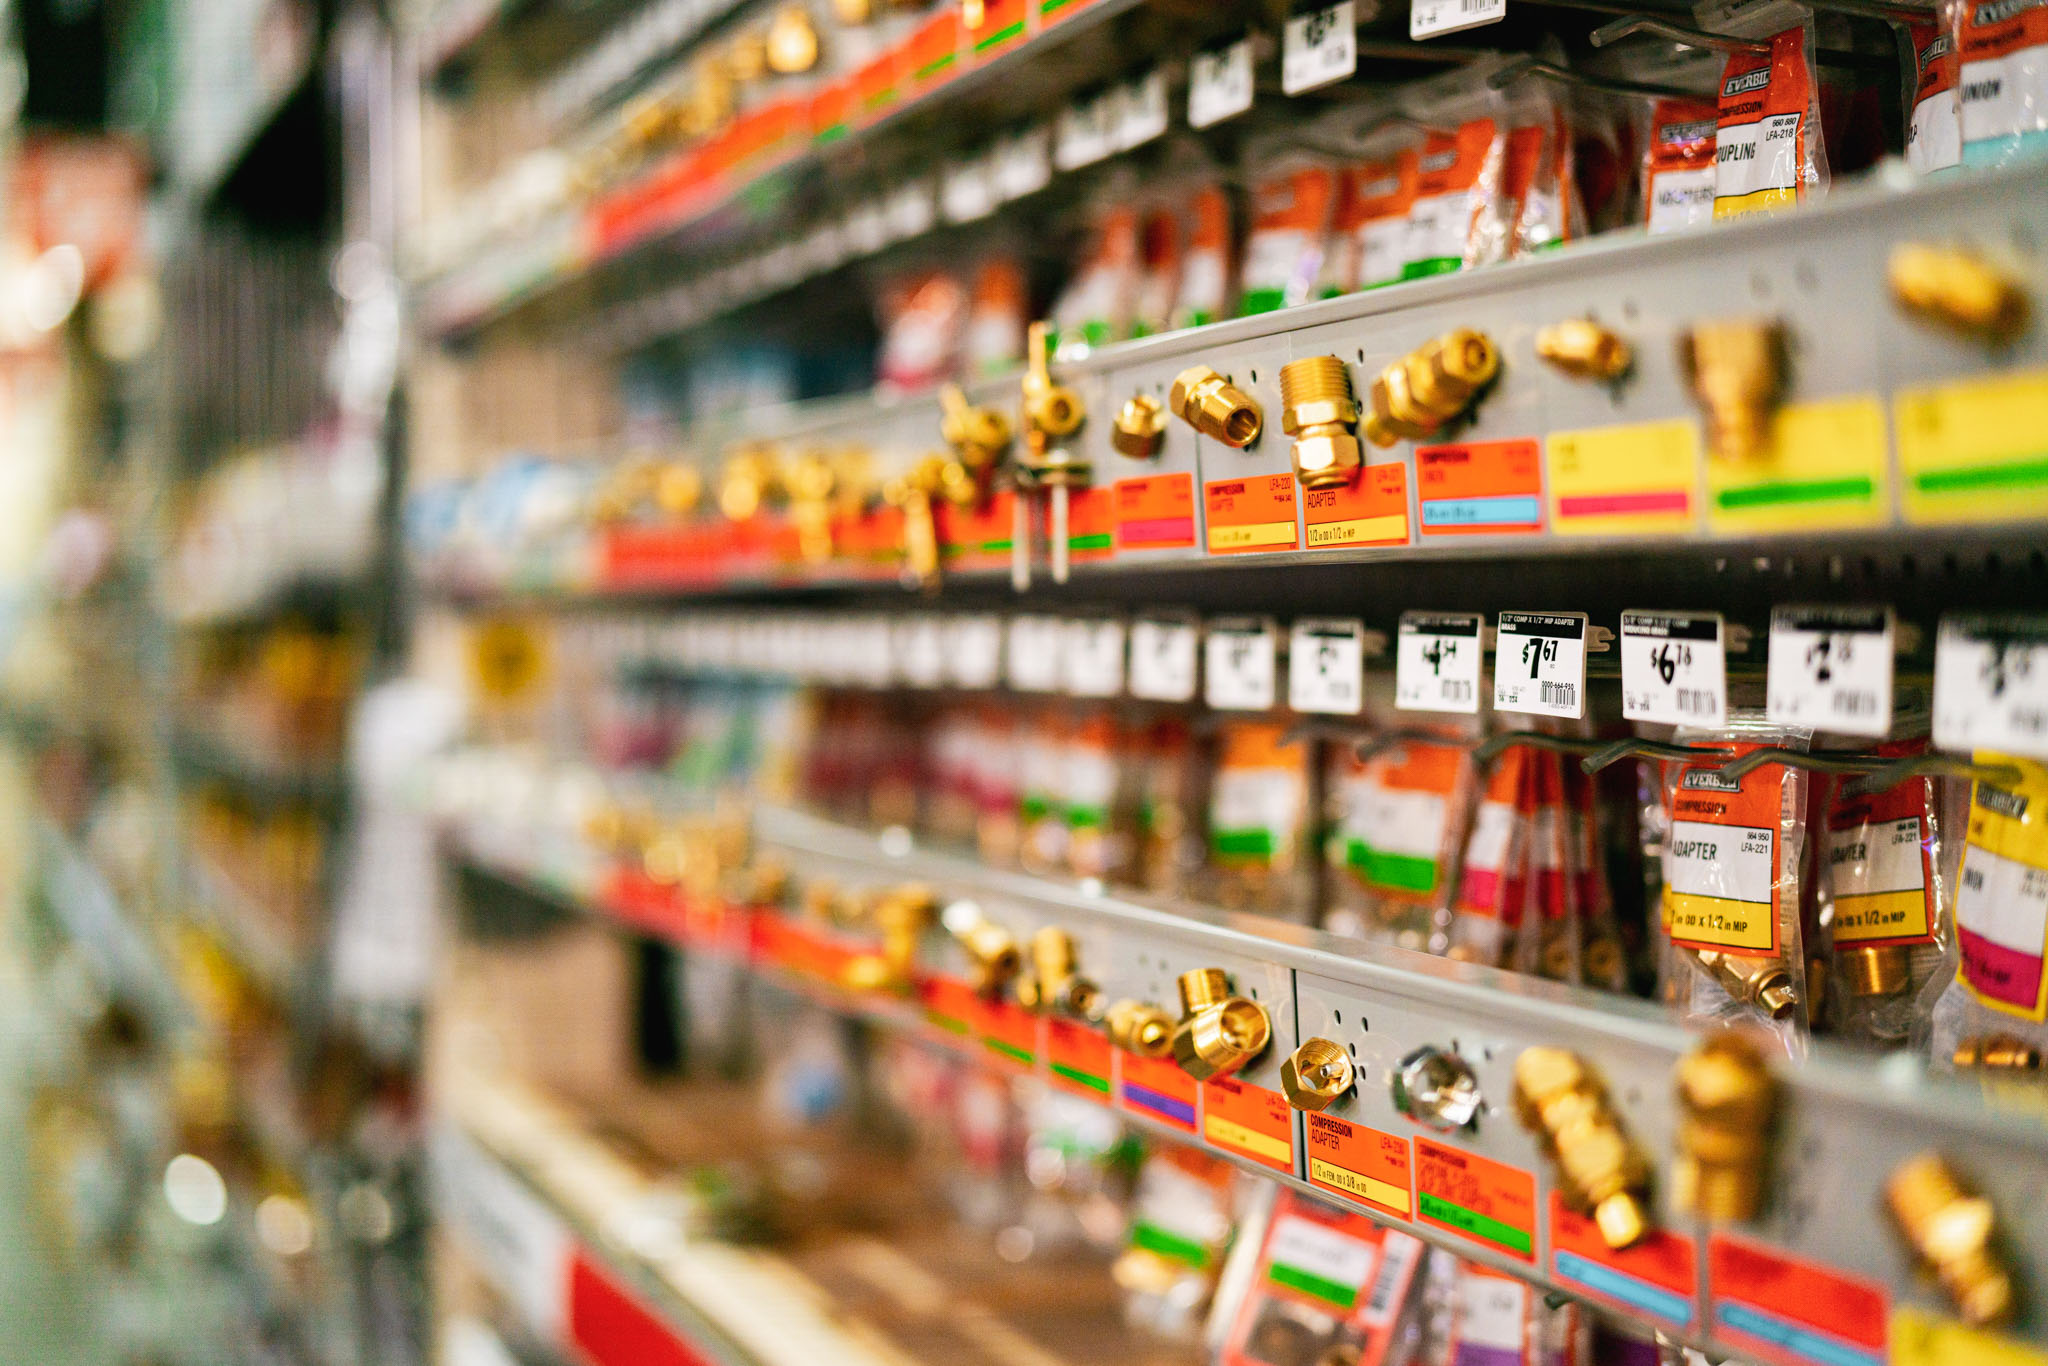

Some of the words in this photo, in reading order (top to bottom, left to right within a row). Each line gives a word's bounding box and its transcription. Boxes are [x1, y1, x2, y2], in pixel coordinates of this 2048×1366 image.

[1765, 128, 1794, 141] LFA-218
[1307, 491, 1336, 509] ADAPTER
[1309, 529, 1318, 541] 1/2
[1501, 623, 1516, 631] BRASS
[1554, 618, 1575, 626] ADAPTER
[1741, 842, 1768, 854] LFA-221
[1708, 913, 1724, 930] 1/2
[1733, 920, 1748, 932] MIP
[1864, 910, 1880, 926] 1/2
[1890, 910, 1906, 923] MIP
[1310, 1113, 1353, 1139] COMPRESSION
[1312, 1128, 1340, 1151] ADAPTER
[1346, 1174, 1355, 1189] 3/8
